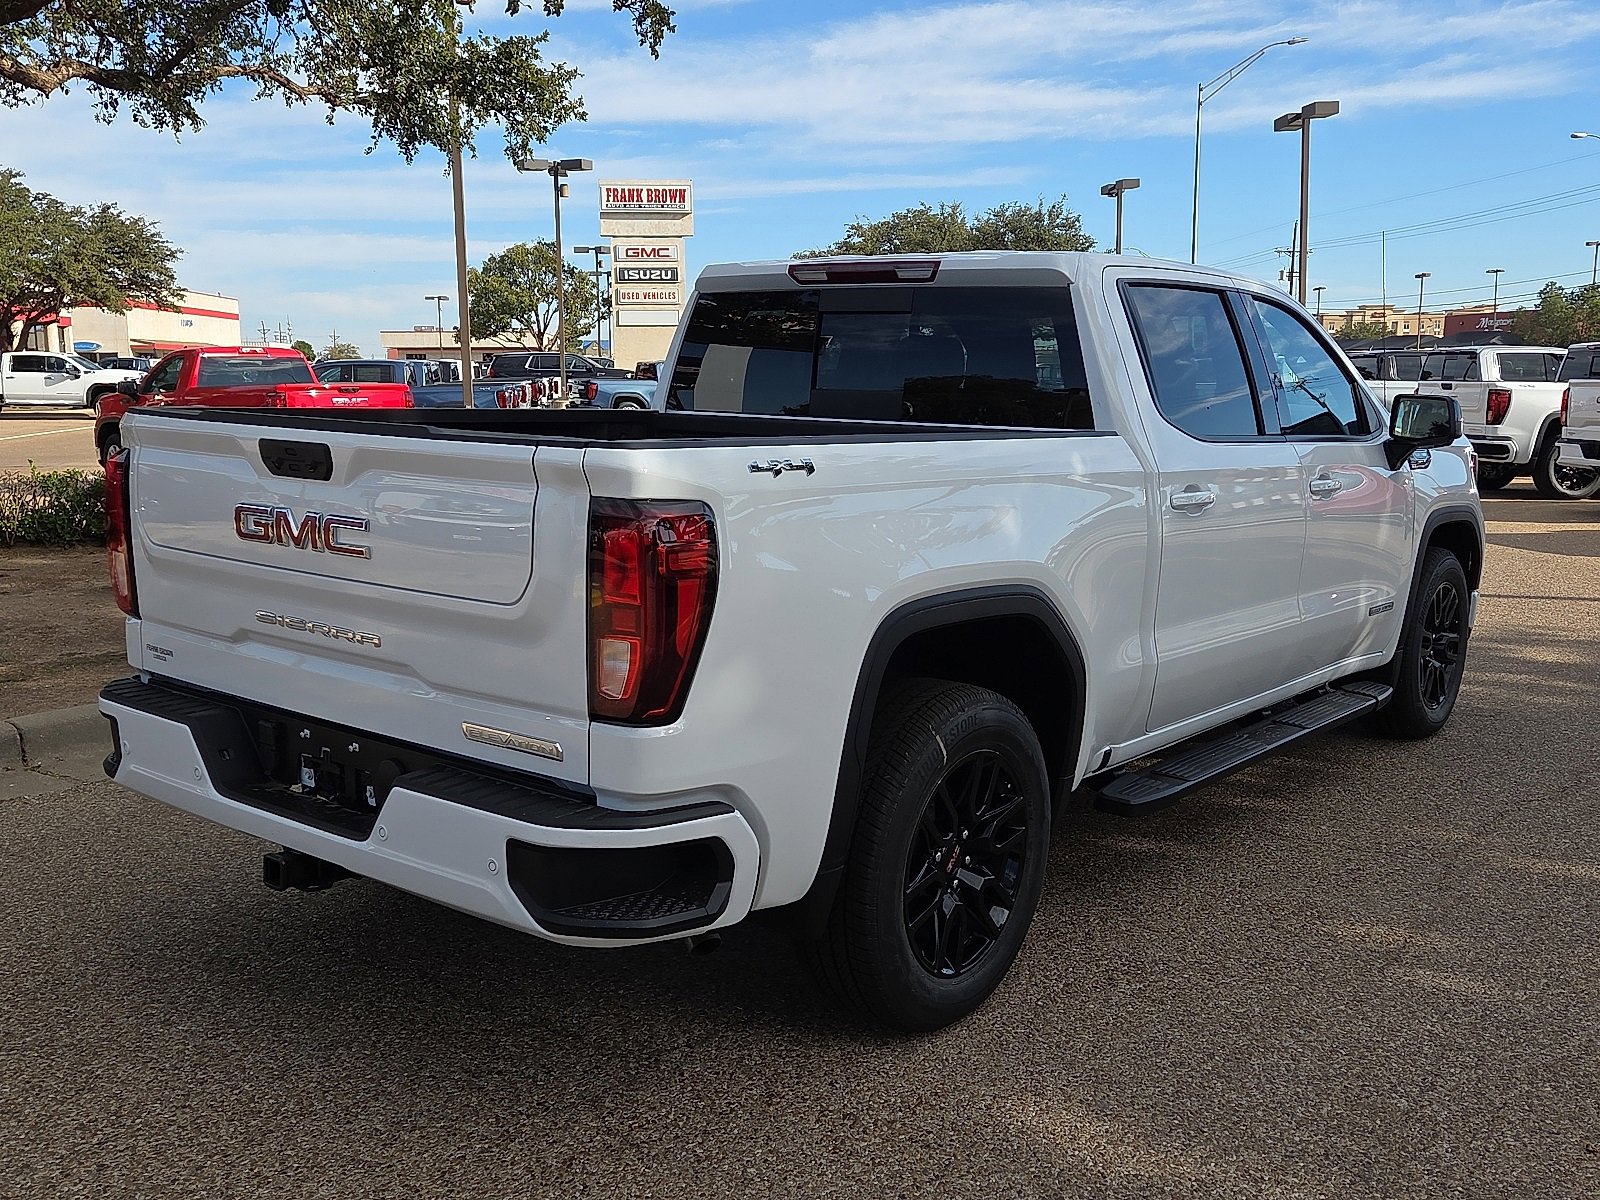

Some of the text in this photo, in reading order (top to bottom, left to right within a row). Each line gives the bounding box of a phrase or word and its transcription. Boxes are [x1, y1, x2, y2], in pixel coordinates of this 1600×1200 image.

[606, 188, 686, 203] FRANK BROWN
[625, 248, 670, 257] GMC
[624, 270, 671, 280] ISUZU
[621, 292, 676, 300] USED VEHICLES
[234, 502, 371, 559] GMC
[255, 610, 382, 648] SIERRA
